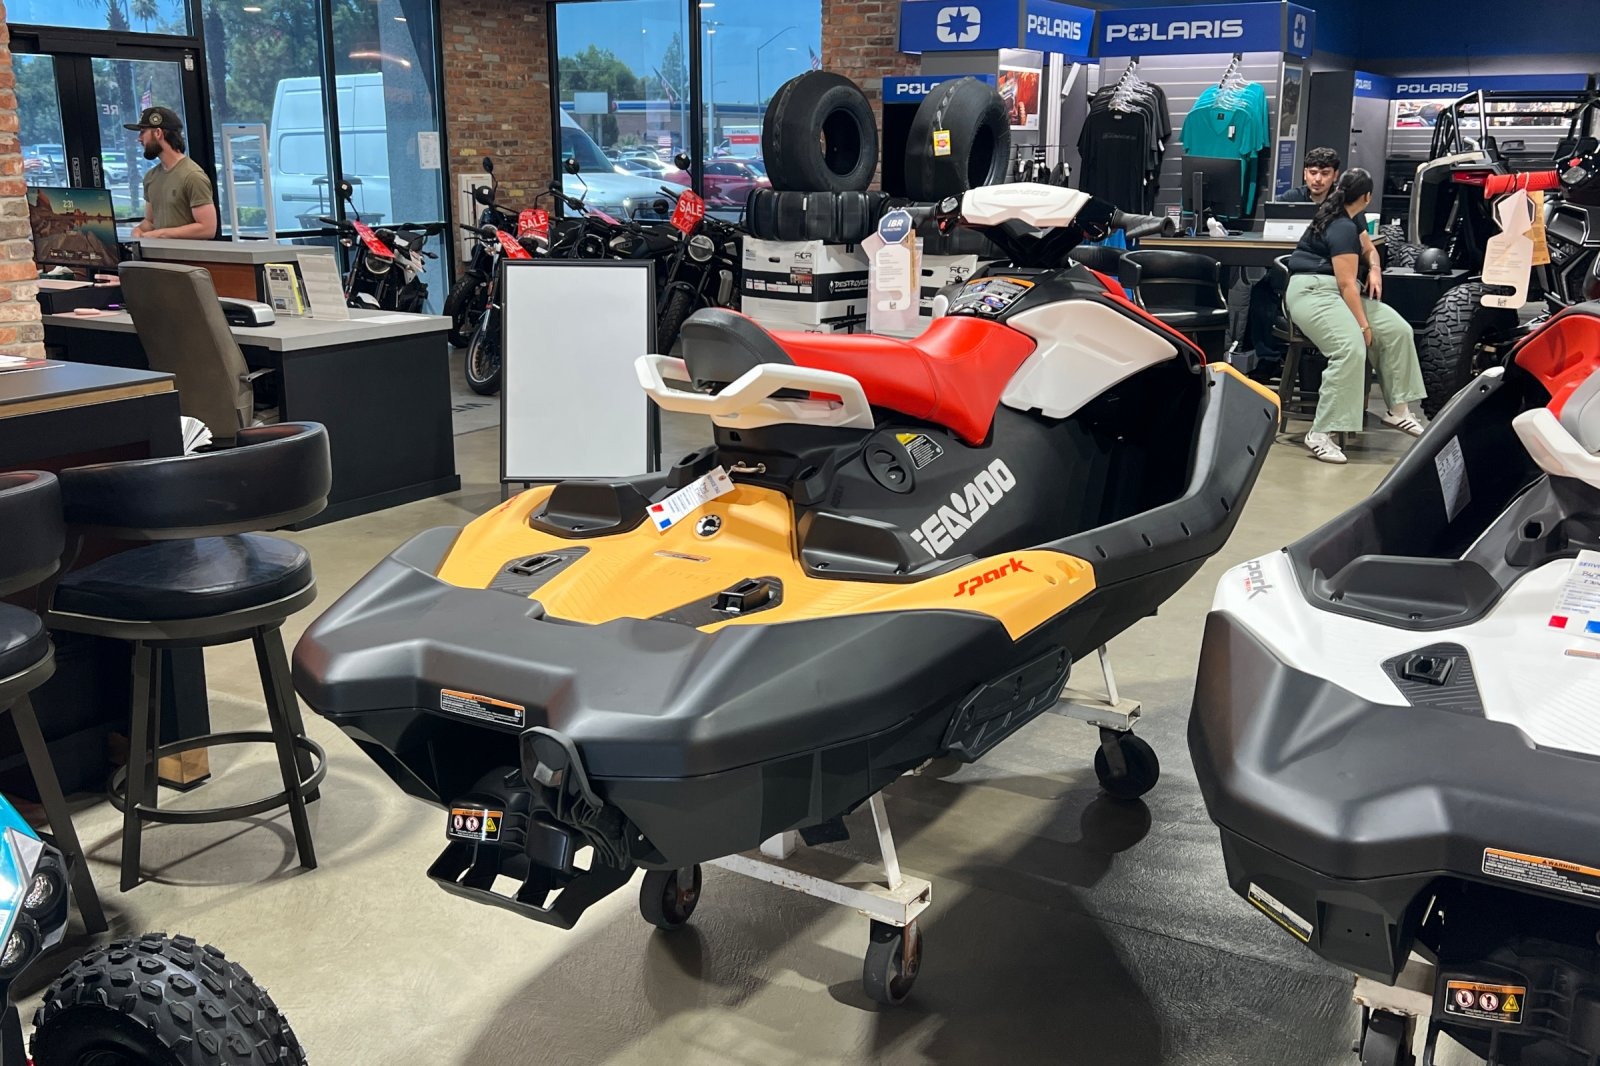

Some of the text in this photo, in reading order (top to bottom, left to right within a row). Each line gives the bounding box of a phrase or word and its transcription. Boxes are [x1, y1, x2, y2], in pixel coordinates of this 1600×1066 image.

[1027, 14, 1081, 41] POLARIS
[1106, 19, 1243, 43] POLARIS
[896, 82, 940, 95] POL
[1396, 82, 1469, 94] POLARIS
[680, 199, 703, 217] SALE
[520, 214, 547, 231] SALE
[888, 219, 904, 228] IBR
